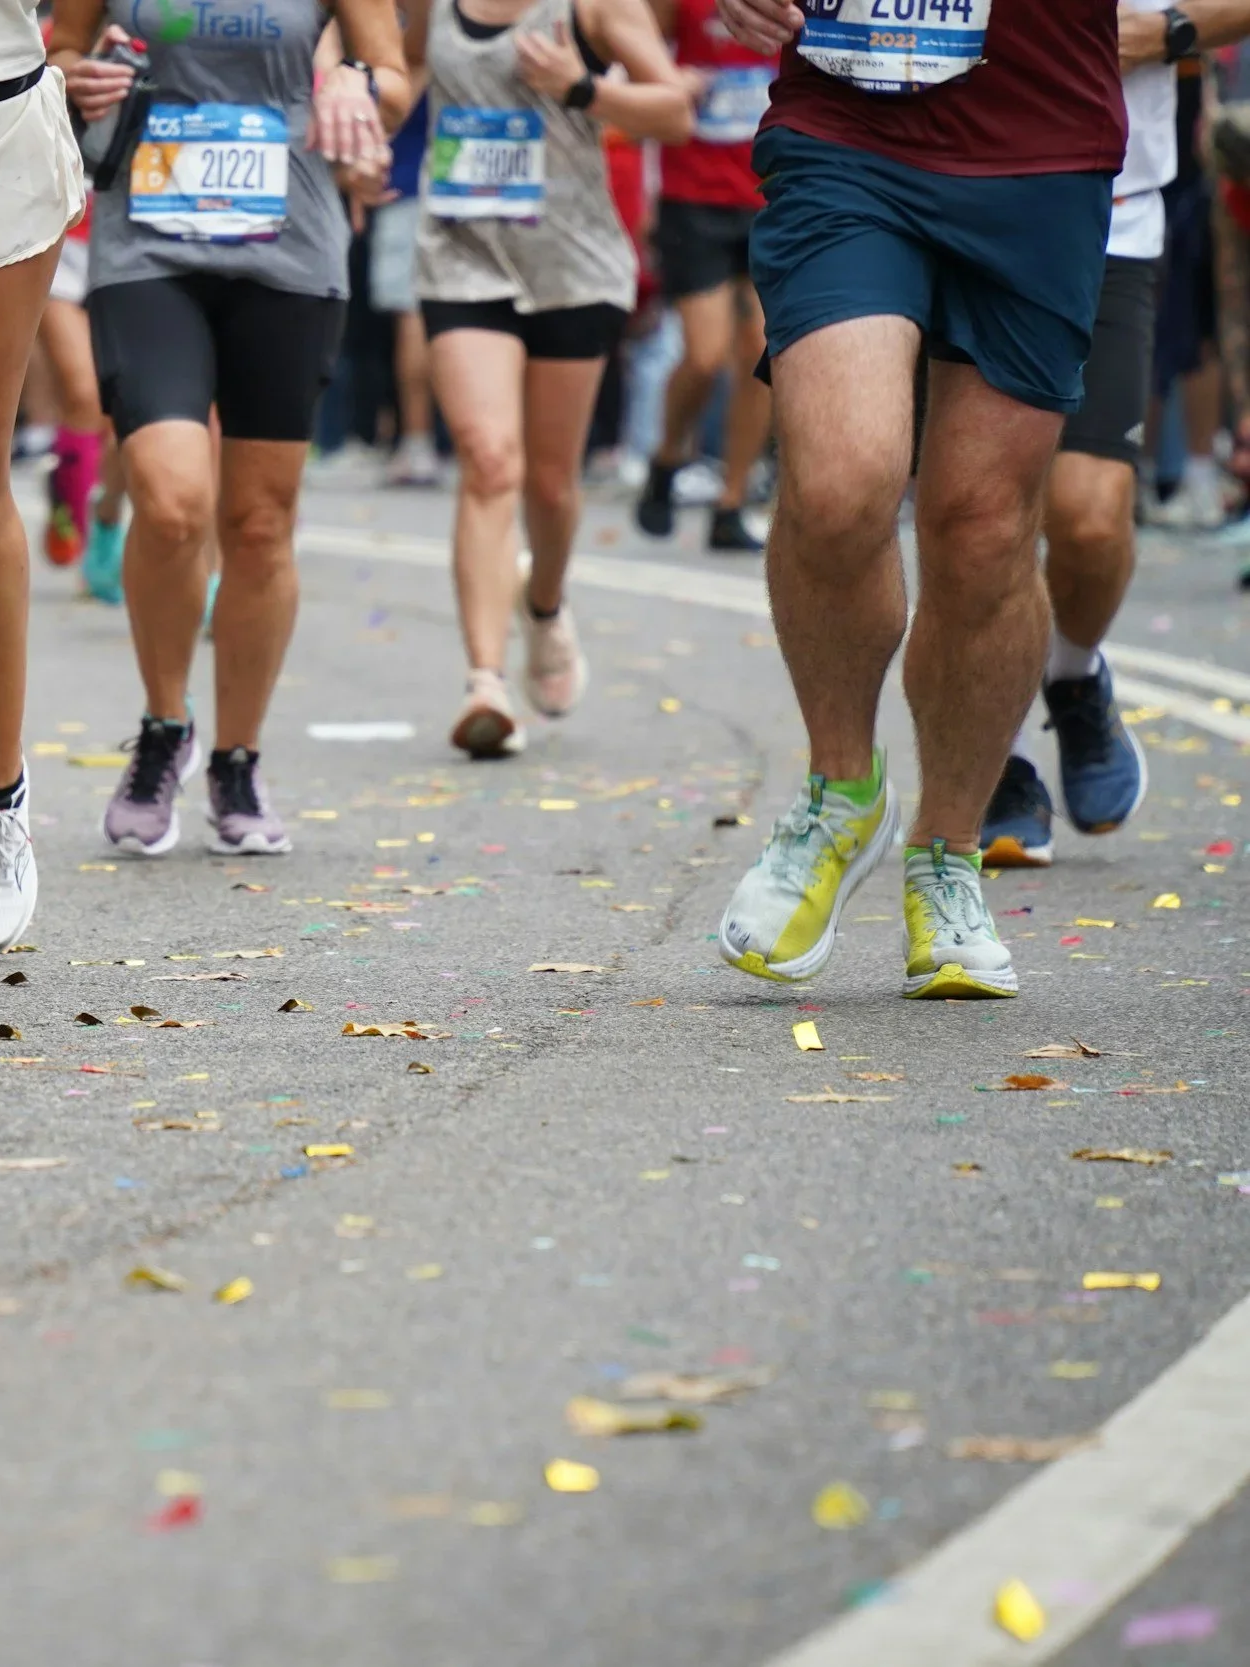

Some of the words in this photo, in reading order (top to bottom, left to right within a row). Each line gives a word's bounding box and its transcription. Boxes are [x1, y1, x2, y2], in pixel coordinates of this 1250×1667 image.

[191, 0, 282, 39] Trails
[868, 31, 918, 49] 2022
[148, 115, 182, 137] tcs
[201, 148, 265, 190] 21221
